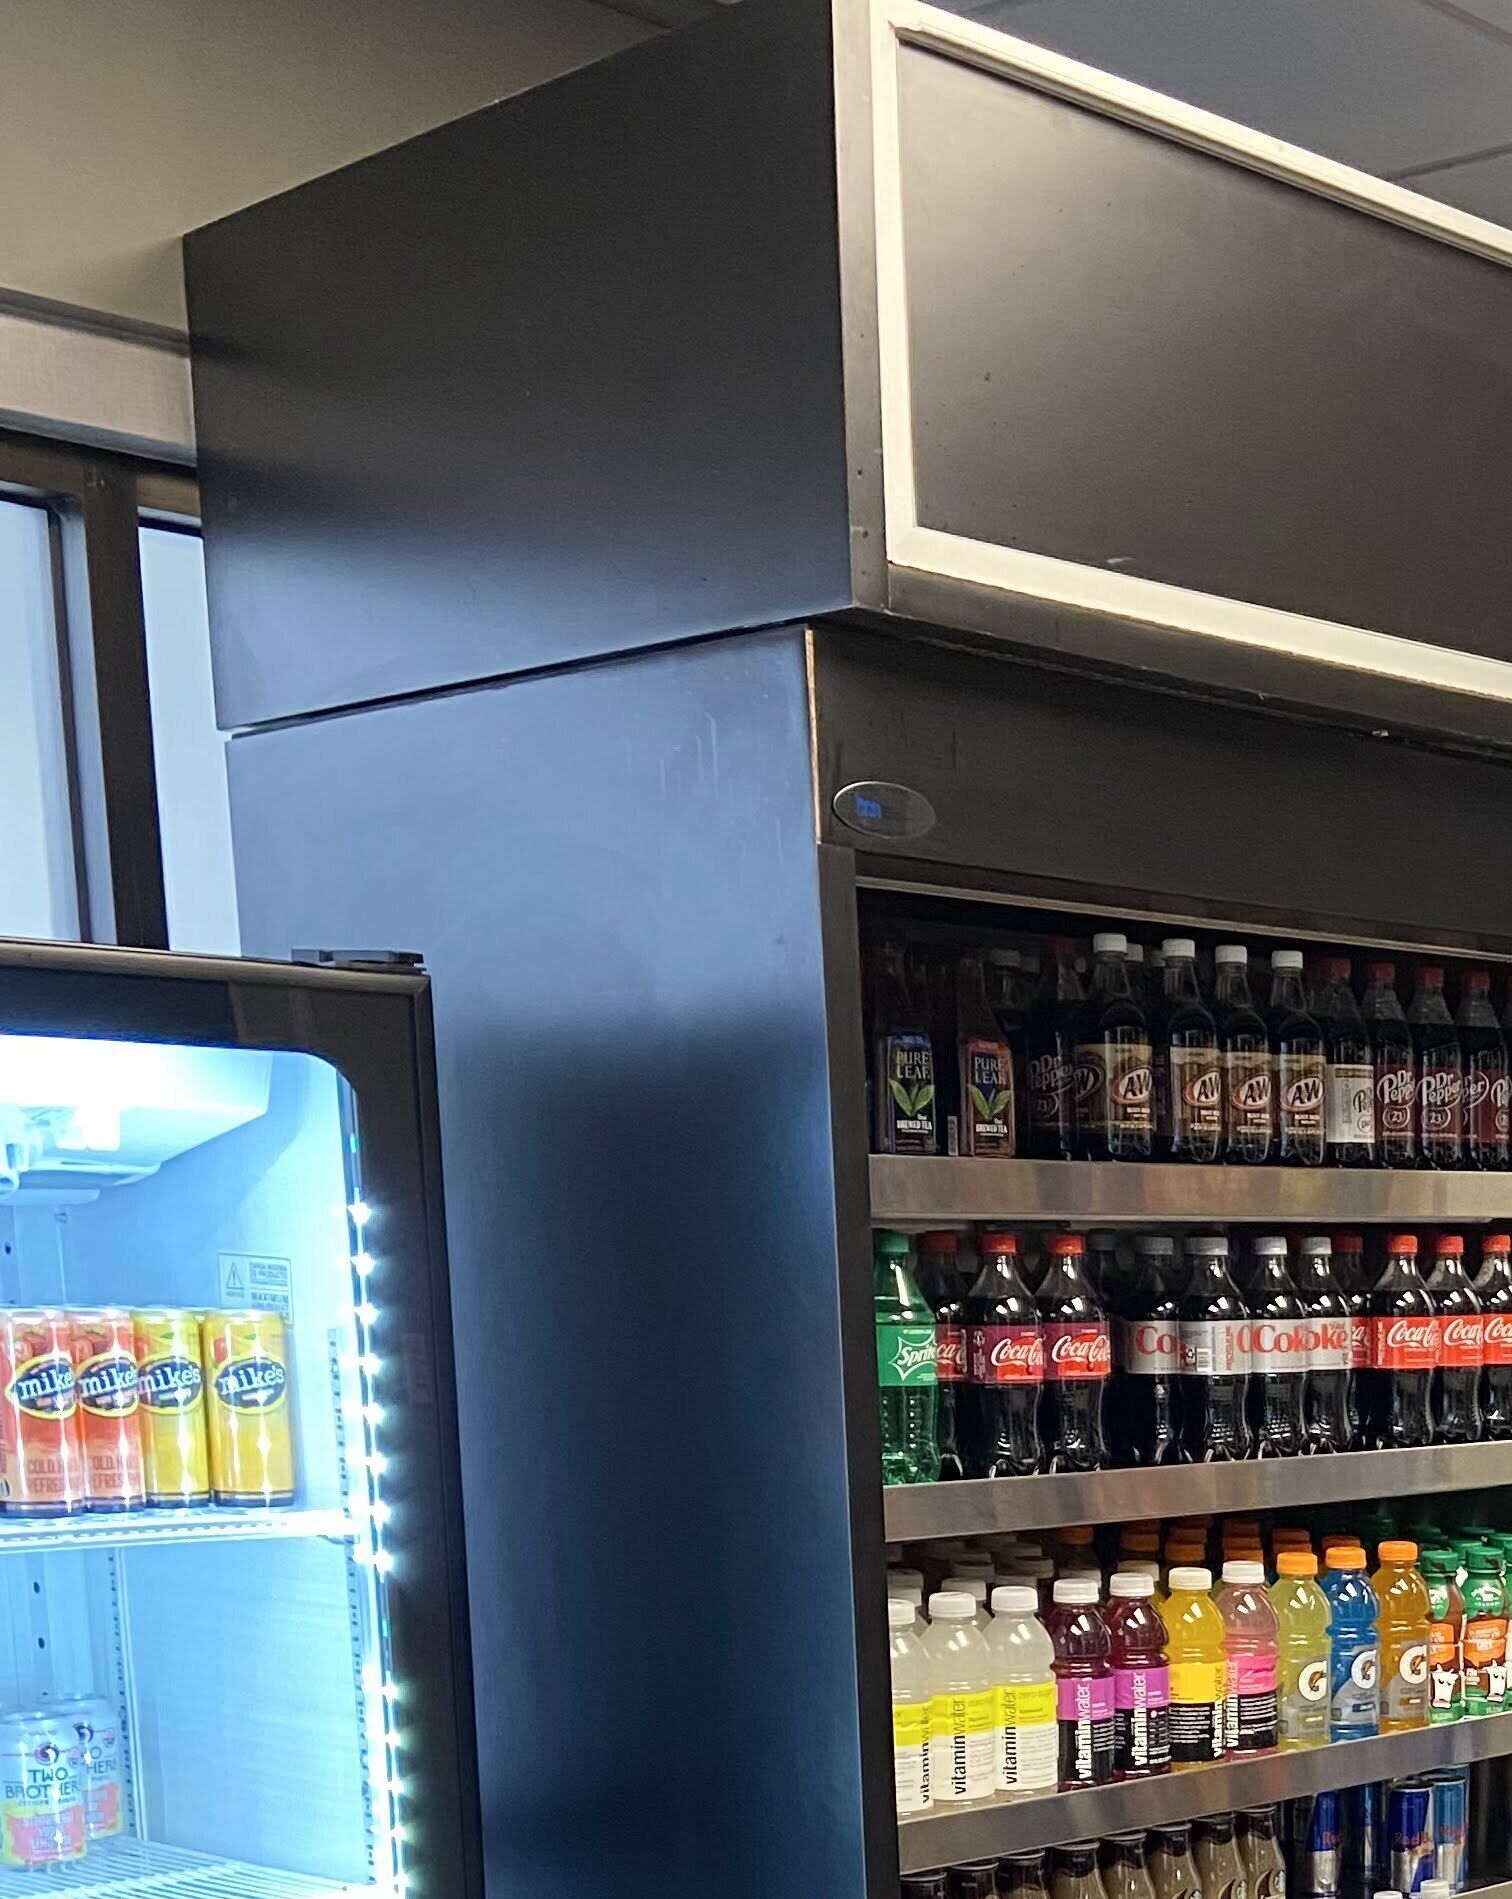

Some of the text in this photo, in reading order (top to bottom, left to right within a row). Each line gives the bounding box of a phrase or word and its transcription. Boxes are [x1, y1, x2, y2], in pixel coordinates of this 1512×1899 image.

[896, 1050, 931, 1066] PURE
[897, 1064, 931, 1080] LEAF
[18, 1370, 74, 1401] mike
[899, 1345, 936, 1367] Sprit
[952, 1698, 967, 1795] vitaminwater
[1003, 1688, 1017, 1785] vitaminwater
[1075, 1683, 1092, 1779] vitaminwater
[1131, 1672, 1148, 1766] vitaminwater
